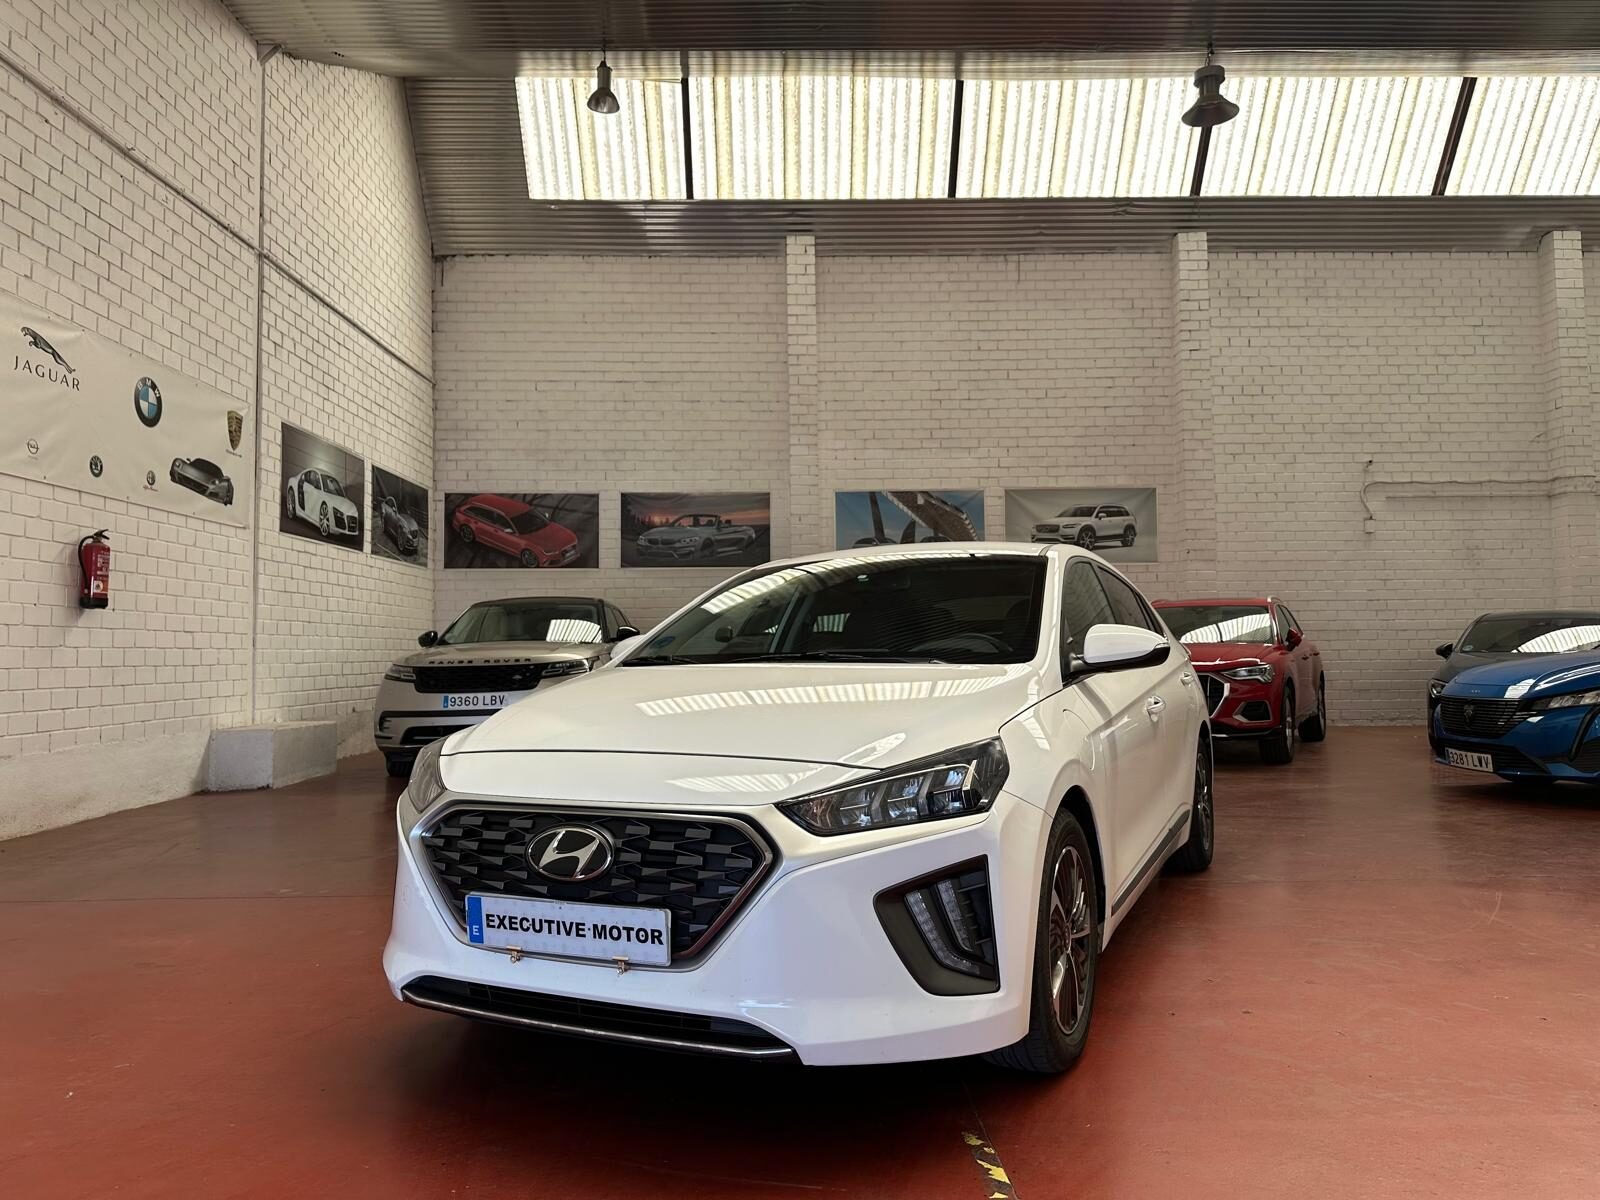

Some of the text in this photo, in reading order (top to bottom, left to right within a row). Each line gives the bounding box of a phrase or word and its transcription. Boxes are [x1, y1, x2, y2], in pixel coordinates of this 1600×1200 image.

[14, 355, 80, 391] JAGUAR
[137, 378, 160, 397] BMW
[449, 695, 505, 706] 9360 LBV
[1449, 751, 1470, 767] 3281
[472, 925, 480, 935] E
[485, 913, 664, 946] EXECUTIVE MOTOR
